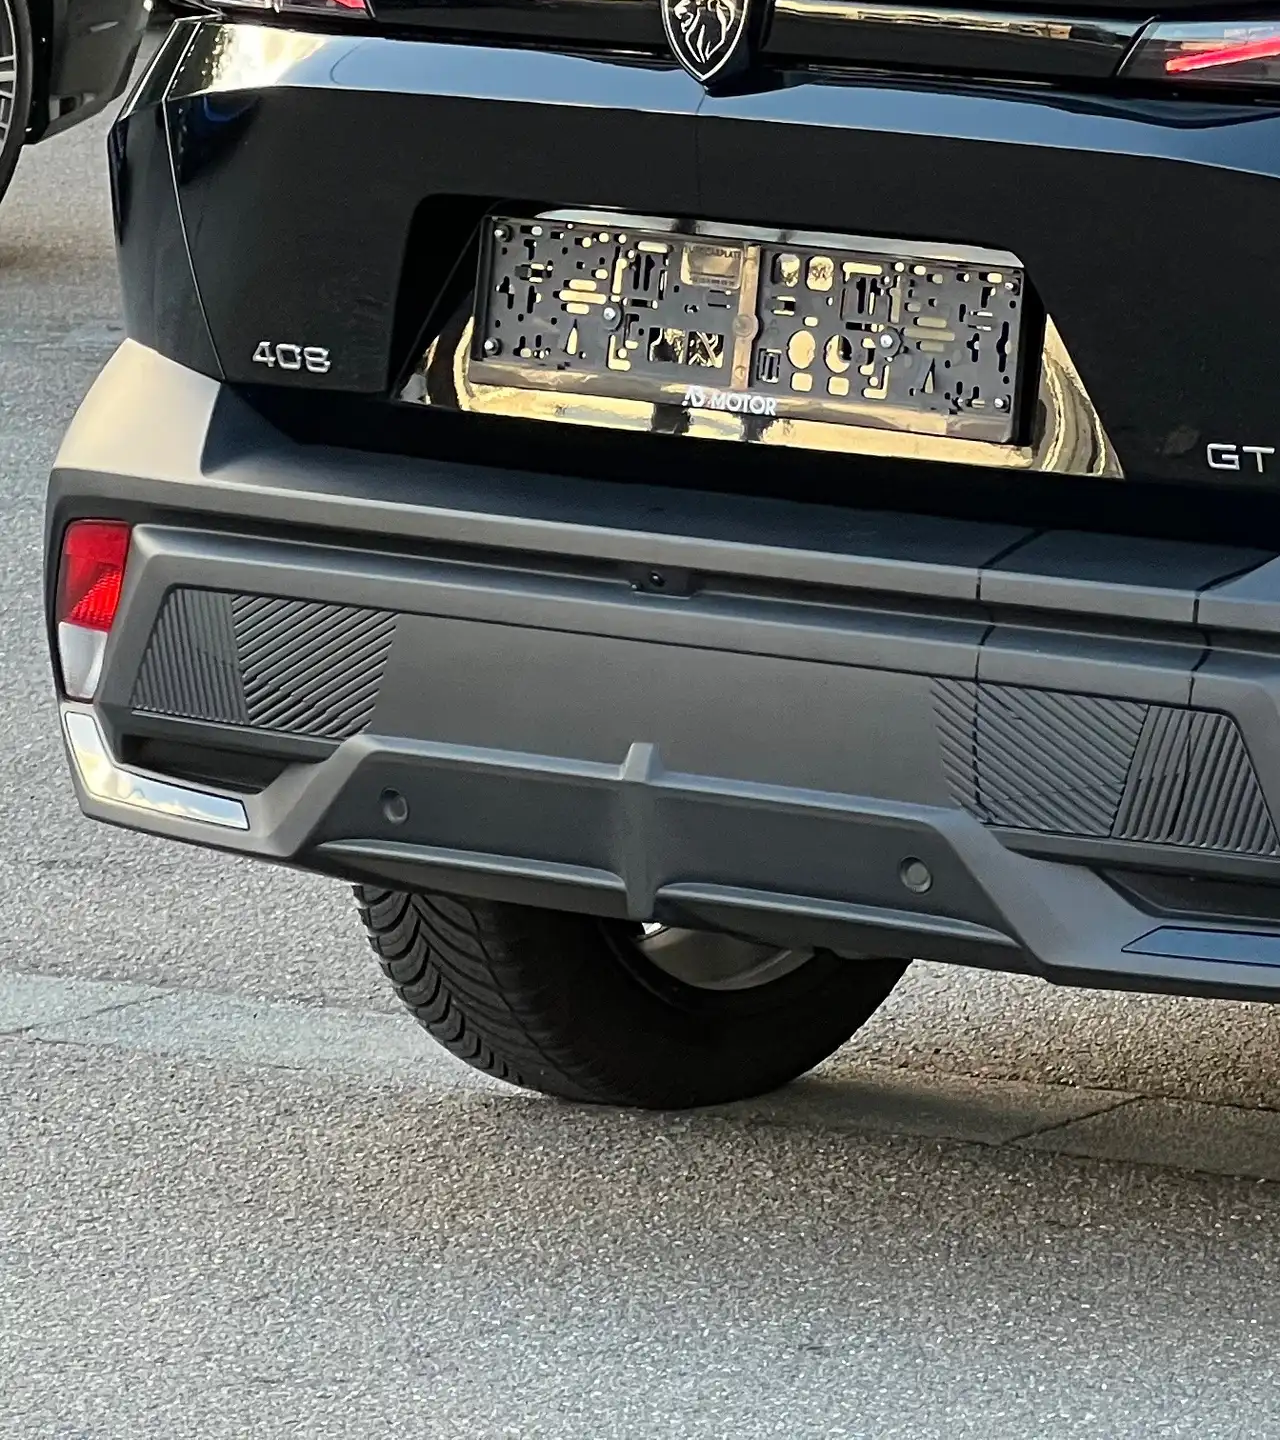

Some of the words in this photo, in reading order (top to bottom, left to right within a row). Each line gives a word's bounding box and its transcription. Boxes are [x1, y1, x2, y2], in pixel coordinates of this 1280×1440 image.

[252, 341, 331, 374] 408
[710, 392, 777, 417] MOTOR
[1206, 443, 1276, 474] GT
